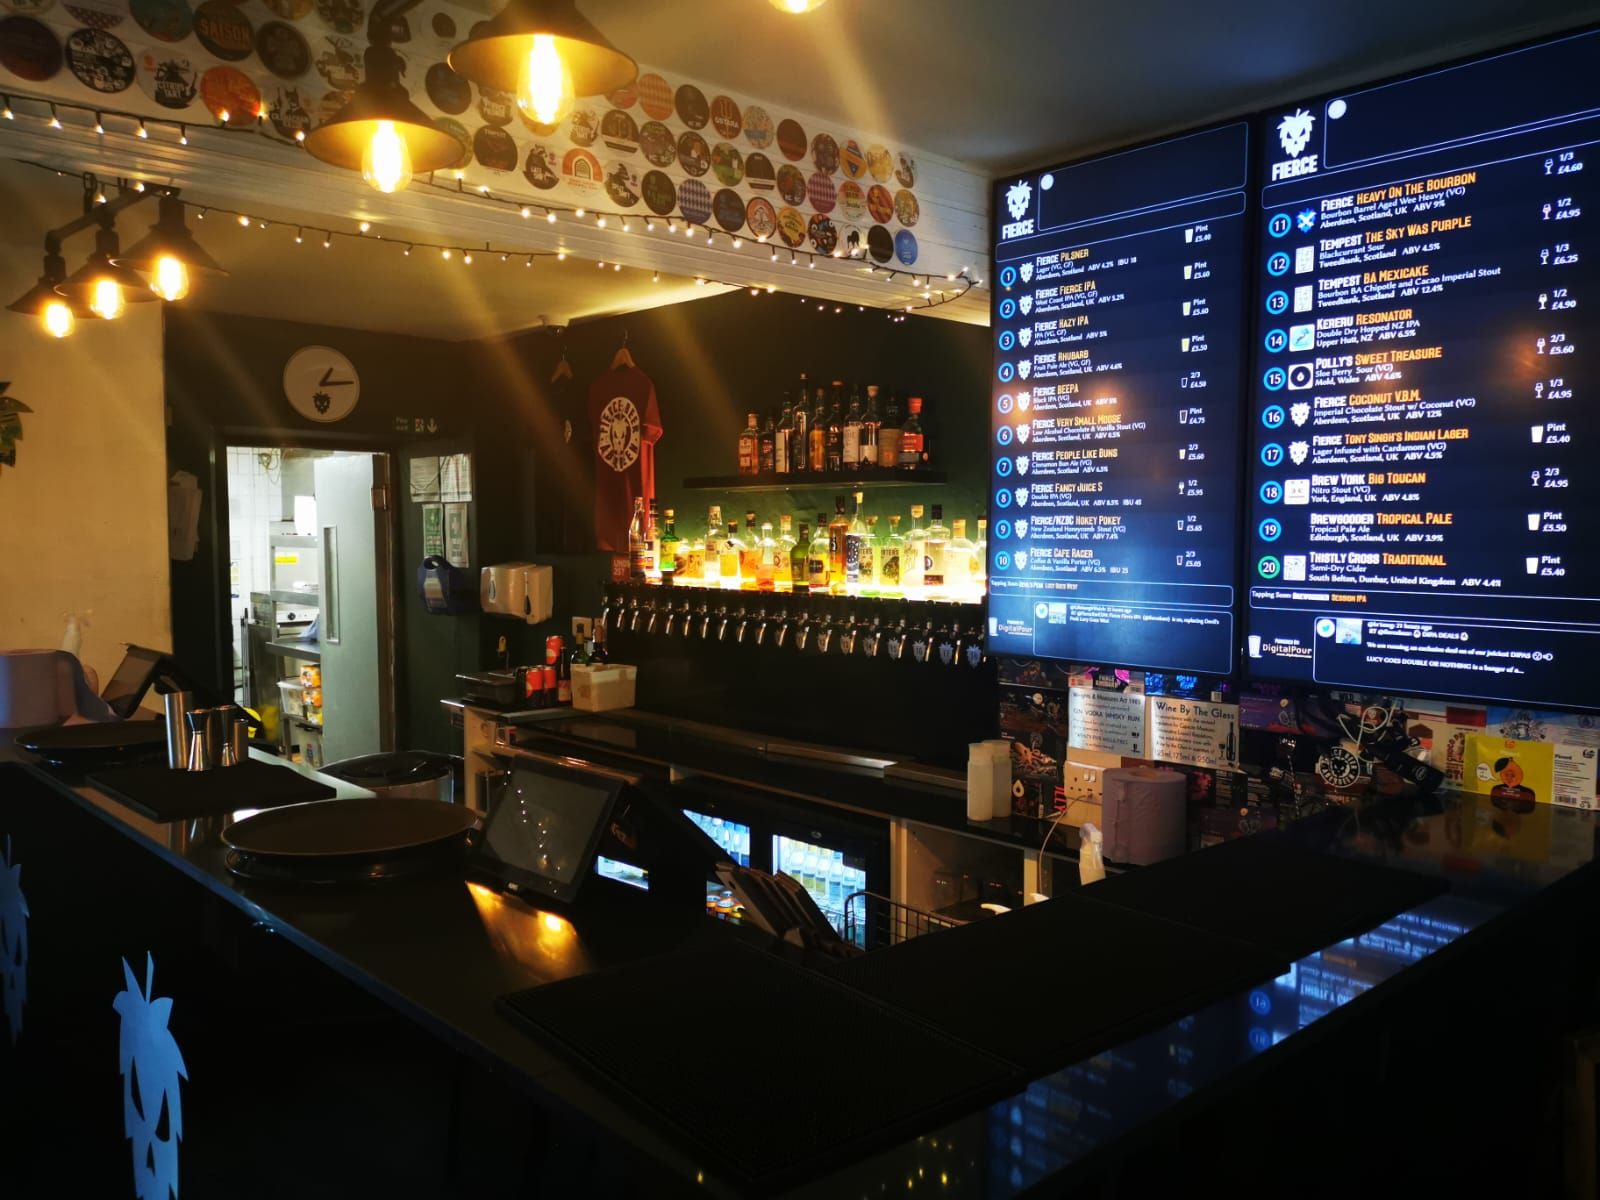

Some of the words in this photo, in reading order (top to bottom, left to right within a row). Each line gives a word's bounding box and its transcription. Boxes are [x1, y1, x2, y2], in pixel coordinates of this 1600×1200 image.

[200, 20, 250, 44] SAISON
[1560, 152, 1574, 161] 1/3
[1271, 154, 1318, 182] FIERCE
[1558, 162, 1583, 174] £4.60
[1321, 196, 1354, 211] FIERCE
[1357, 190, 1387, 204] HEAVY
[1389, 186, 1402, 198] ON
[1405, 182, 1424, 195] THE
[1427, 172, 1476, 191] BOURBON
[1321, 208, 1352, 220] Bourbon
[1354, 203, 1376, 216] Barrel
[1377, 198, 1398, 210] Aged
[1399, 195, 1416, 205] Wee
[1418, 190, 1444, 202] Heavy
[1558, 198, 1572, 207] 1/2
[1555, 208, 1580, 220] £4.95
[1002, 219, 1034, 240] FIERCE
[1274, 219, 1286, 232] 11
[1320, 234, 1362, 251] TEMPEST
[1365, 231, 1384, 243] THE
[1386, 228, 1405, 241] SKY
[1407, 223, 1428, 236] WAS
[1432, 216, 1472, 233] PURPLE
[1320, 245, 1366, 259] Blackcurrant
[1367, 243, 1385, 252] Sour
[1555, 244, 1569, 252] 1/3
[1037, 254, 1059, 266] FIERCE
[1273, 258, 1285, 270] 12
[1553, 254, 1578, 265] £6.25
[1318, 274, 1361, 290] TEMPEST
[1364, 272, 1376, 284] BA
[1379, 265, 1429, 282] MEXICAKE
[1318, 287, 1348, 299] Bourbon
[1364, 281, 1396, 295] Chipotle
[1398, 279, 1413, 288] and
[1415, 276, 1440, 286] Cacao
[1442, 270, 1476, 283] Imperial
[1478, 267, 1501, 277] Stout
[1036, 288, 1058, 299] FIERCE
[1084, 280, 1096, 292] IPA
[1553, 289, 1567, 298] 1/2
[1272, 296, 1284, 308] 13
[1552, 300, 1576, 310] £4.90
[1035, 320, 1057, 332] FIERCE
[1078, 316, 1089, 326] IPA
[1317, 316, 1354, 330] KERERU
[1356, 309, 1412, 326] RESONATOR
[1316, 327, 1342, 339] Double
[1344, 326, 1359, 337] Dry
[1360, 322, 1389, 335] Hopped
[1392, 322, 1405, 330] NZ
[1406, 320, 1420, 328] IPA
[1270, 335, 1282, 347] 14
[1549, 345, 1574, 355] £5.60
[1034, 353, 1056, 364] FIERCE
[1316, 356, 1353, 369] POLLY'S
[1355, 352, 1389, 366] SWEET
[1391, 347, 1442, 362] TREASURE
[1332, 367, 1352, 377] Berry
[1356, 366, 1373, 374] Sour
[1269, 373, 1281, 385] 15
[1549, 378, 1563, 387] 1/3
[1033, 386, 1056, 397] FIERCE
[1548, 390, 1572, 399] £4.95
[1314, 395, 1347, 408] FIERCE
[1349, 392, 1392, 406] COCONUT
[1314, 407, 1343, 418] Imperial
[1345, 405, 1383, 415] Chocolate
[1385, 403, 1406, 412] Stout
[1420, 401, 1454, 410] Coconut
[1033, 419, 1055, 429] FIERCE
[1057, 417, 1073, 427] VERY
[1074, 416, 1096, 426] SMALL
[1268, 411, 1280, 423] 16
[1547, 424, 1565, 432] Pint
[1313, 435, 1342, 446] FIERCE
[1345, 433, 1367, 444] TONY
[1368, 431, 1403, 444] SINGH'S
[1404, 430, 1436, 441] INDIAN
[1438, 428, 1468, 440] LAGER
[1546, 435, 1570, 444] £5.40
[1032, 451, 1055, 461] FIERCE
[1056, 450, 1080, 460] PEOPLE
[1082, 449, 1097, 459] LIKE
[1266, 449, 1278, 461] 17
[1313, 447, 1332, 457] Lager
[1334, 446, 1361, 455] Infused
[1363, 445, 1380, 453] with
[1544, 468, 1559, 476] 2/3
[1312, 474, 1339, 486] BREW
[1341, 473, 1365, 485] YORK
[1368, 473, 1384, 484] BIG
[1387, 472, 1426, 484] TOUCAN
[1544, 479, 1568, 488] £4.95
[1265, 487, 1278, 498] 18
[1332, 486, 1351, 494] Stout
[1310, 513, 1374, 524] BREWGOODER
[1377, 513, 1424, 525] TROPICAL
[1426, 512, 1452, 525] PALE
[1544, 512, 1562, 520] Pint
[1264, 524, 1277, 536] 19
[1310, 525, 1338, 535] Tropical
[1340, 525, 1356, 533] Pale
[1542, 524, 1567, 532] £5.50
[999, 556, 1007, 565] 10
[1310, 552, 1346, 564] THISTLY
[1348, 552, 1380, 564] CROSS
[1382, 553, 1446, 566] TRADITIONAL
[1542, 556, 1560, 564] Pint
[1263, 562, 1276, 573] 20
[1541, 568, 1565, 576] £5.40
[1262, 644, 1312, 655] DigitalPour
[1156, 702, 1176, 713] Wine
[1180, 704, 1190, 715] By
[1193, 705, 1208, 717] The
[1211, 708, 1235, 720] Glass
